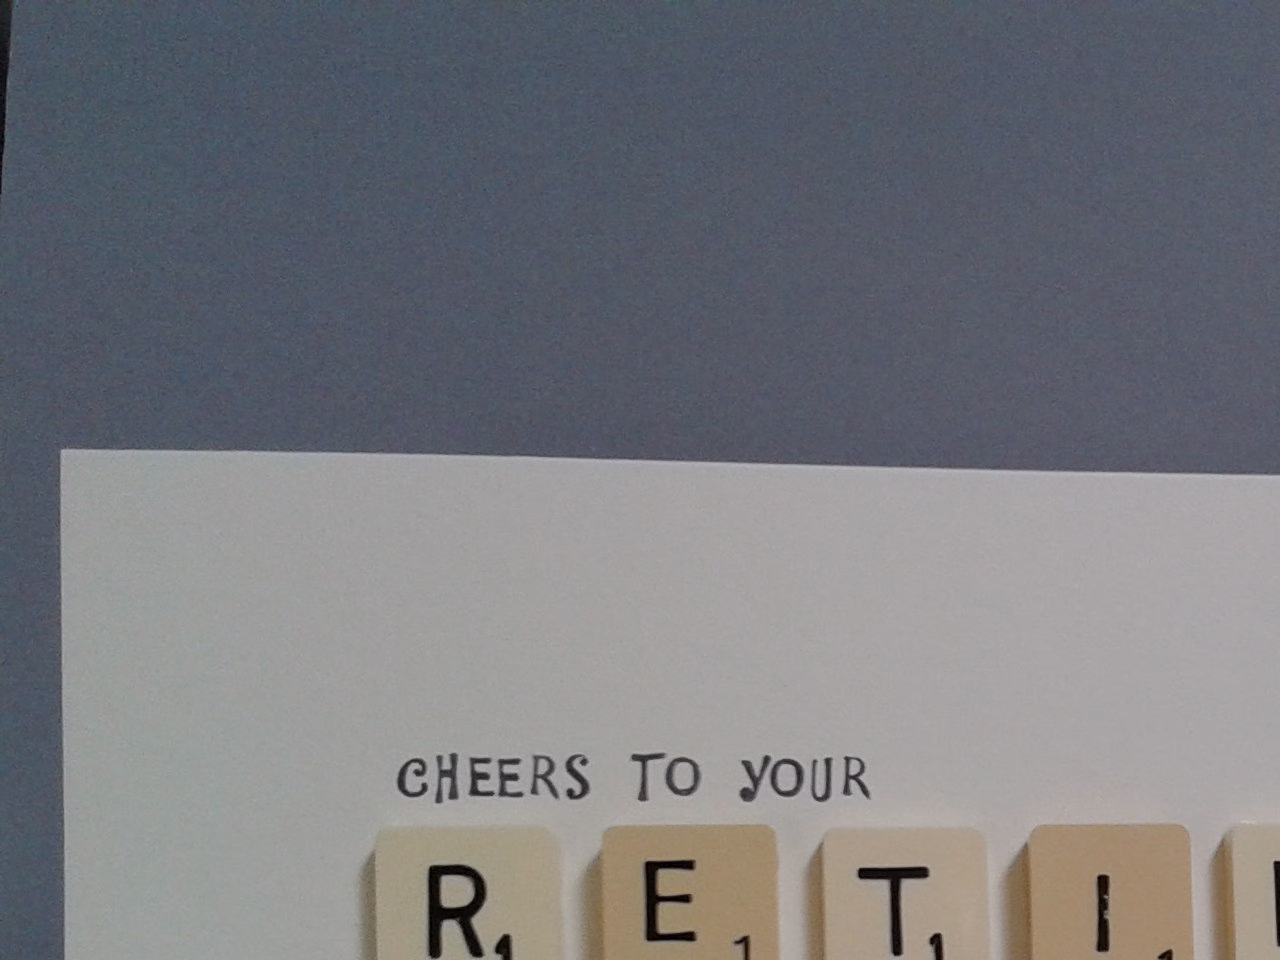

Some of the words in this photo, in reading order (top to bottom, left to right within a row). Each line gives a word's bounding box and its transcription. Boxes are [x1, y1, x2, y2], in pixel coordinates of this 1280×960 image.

[396, 752, 591, 804] CHEERS
[631, 752, 701, 802] TO
[739, 754, 871, 803] YOUR
